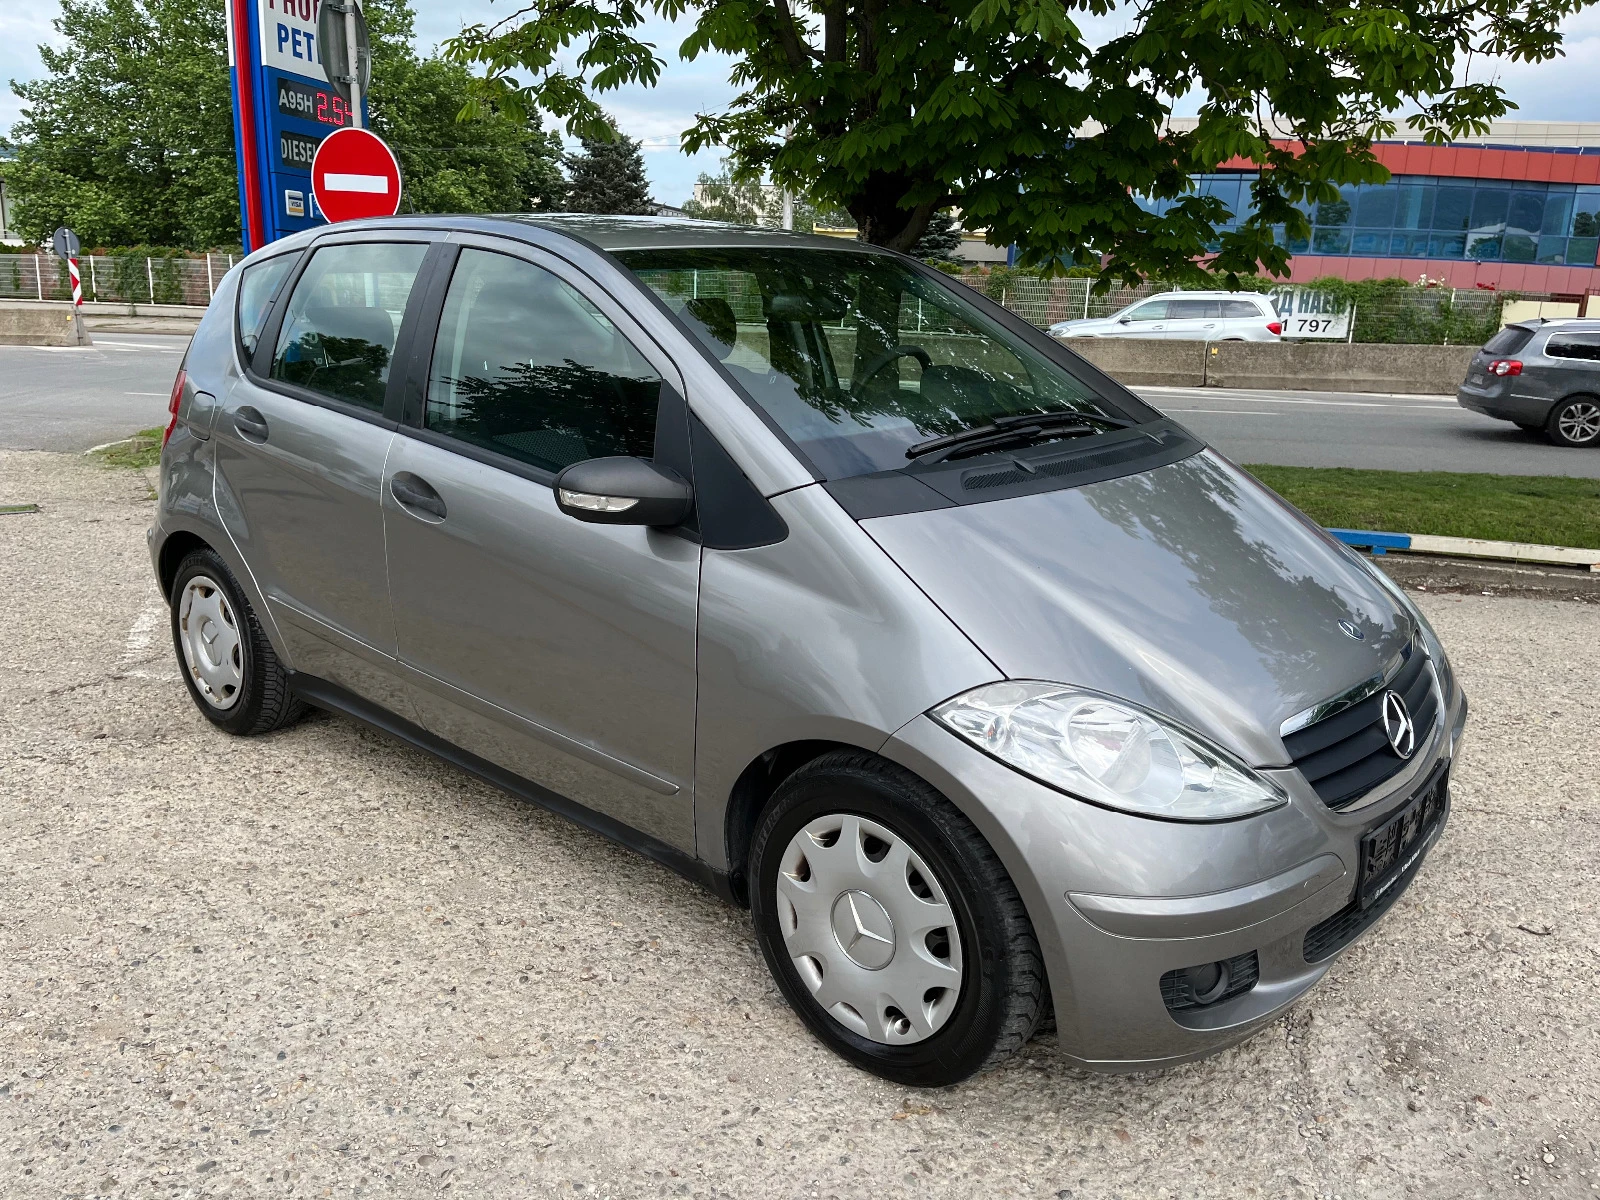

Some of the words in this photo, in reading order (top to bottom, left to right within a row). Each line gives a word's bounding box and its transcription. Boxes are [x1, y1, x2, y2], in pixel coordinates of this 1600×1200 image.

[277, 22, 321, 64] PET
[279, 88, 313, 113] A95H
[1298, 319, 1332, 333] 797
